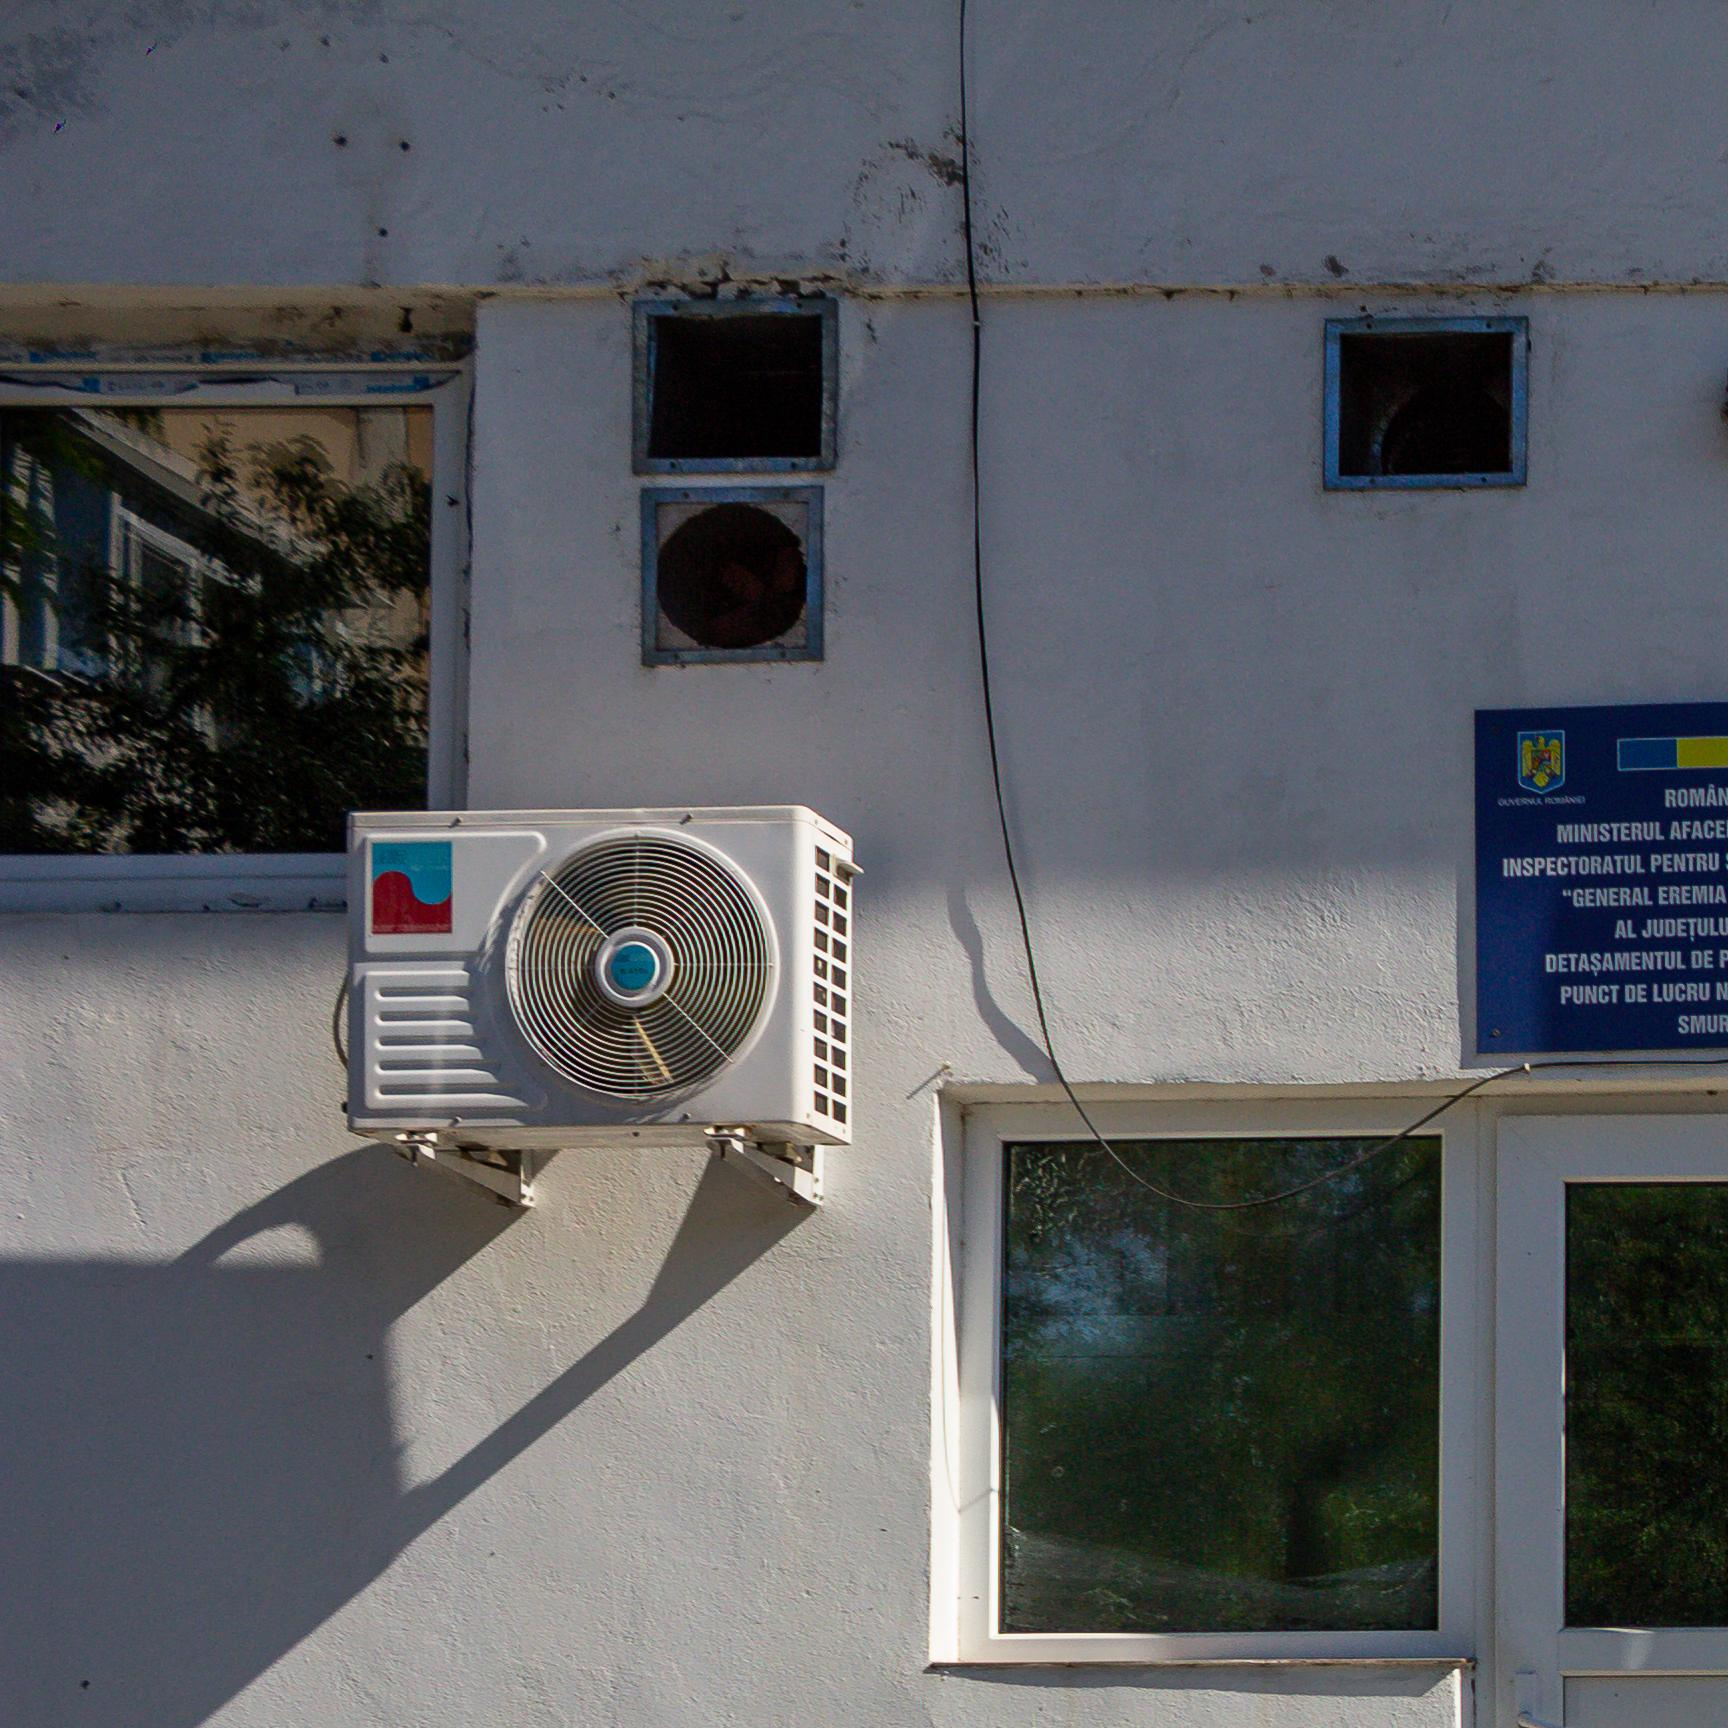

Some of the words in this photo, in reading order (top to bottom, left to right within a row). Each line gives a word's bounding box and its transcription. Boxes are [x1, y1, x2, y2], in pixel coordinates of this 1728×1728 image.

[1556, 822, 1665, 843] MINISTERUL
[1502, 855, 1646, 877] INSPECTORATUL
[1650, 852, 1720, 873] PENTRU
[1658, 885, 1727, 905] EREMIA
[1614, 919, 1637, 939] AL
[1545, 951, 1687, 977] DETAȘAMENTUL
[1691, 949, 1714, 970] DE
[1560, 985, 1620, 1005] PUNCT
[1624, 983, 1648, 1003] DE
[1652, 982, 1711, 1002] LUCRU
